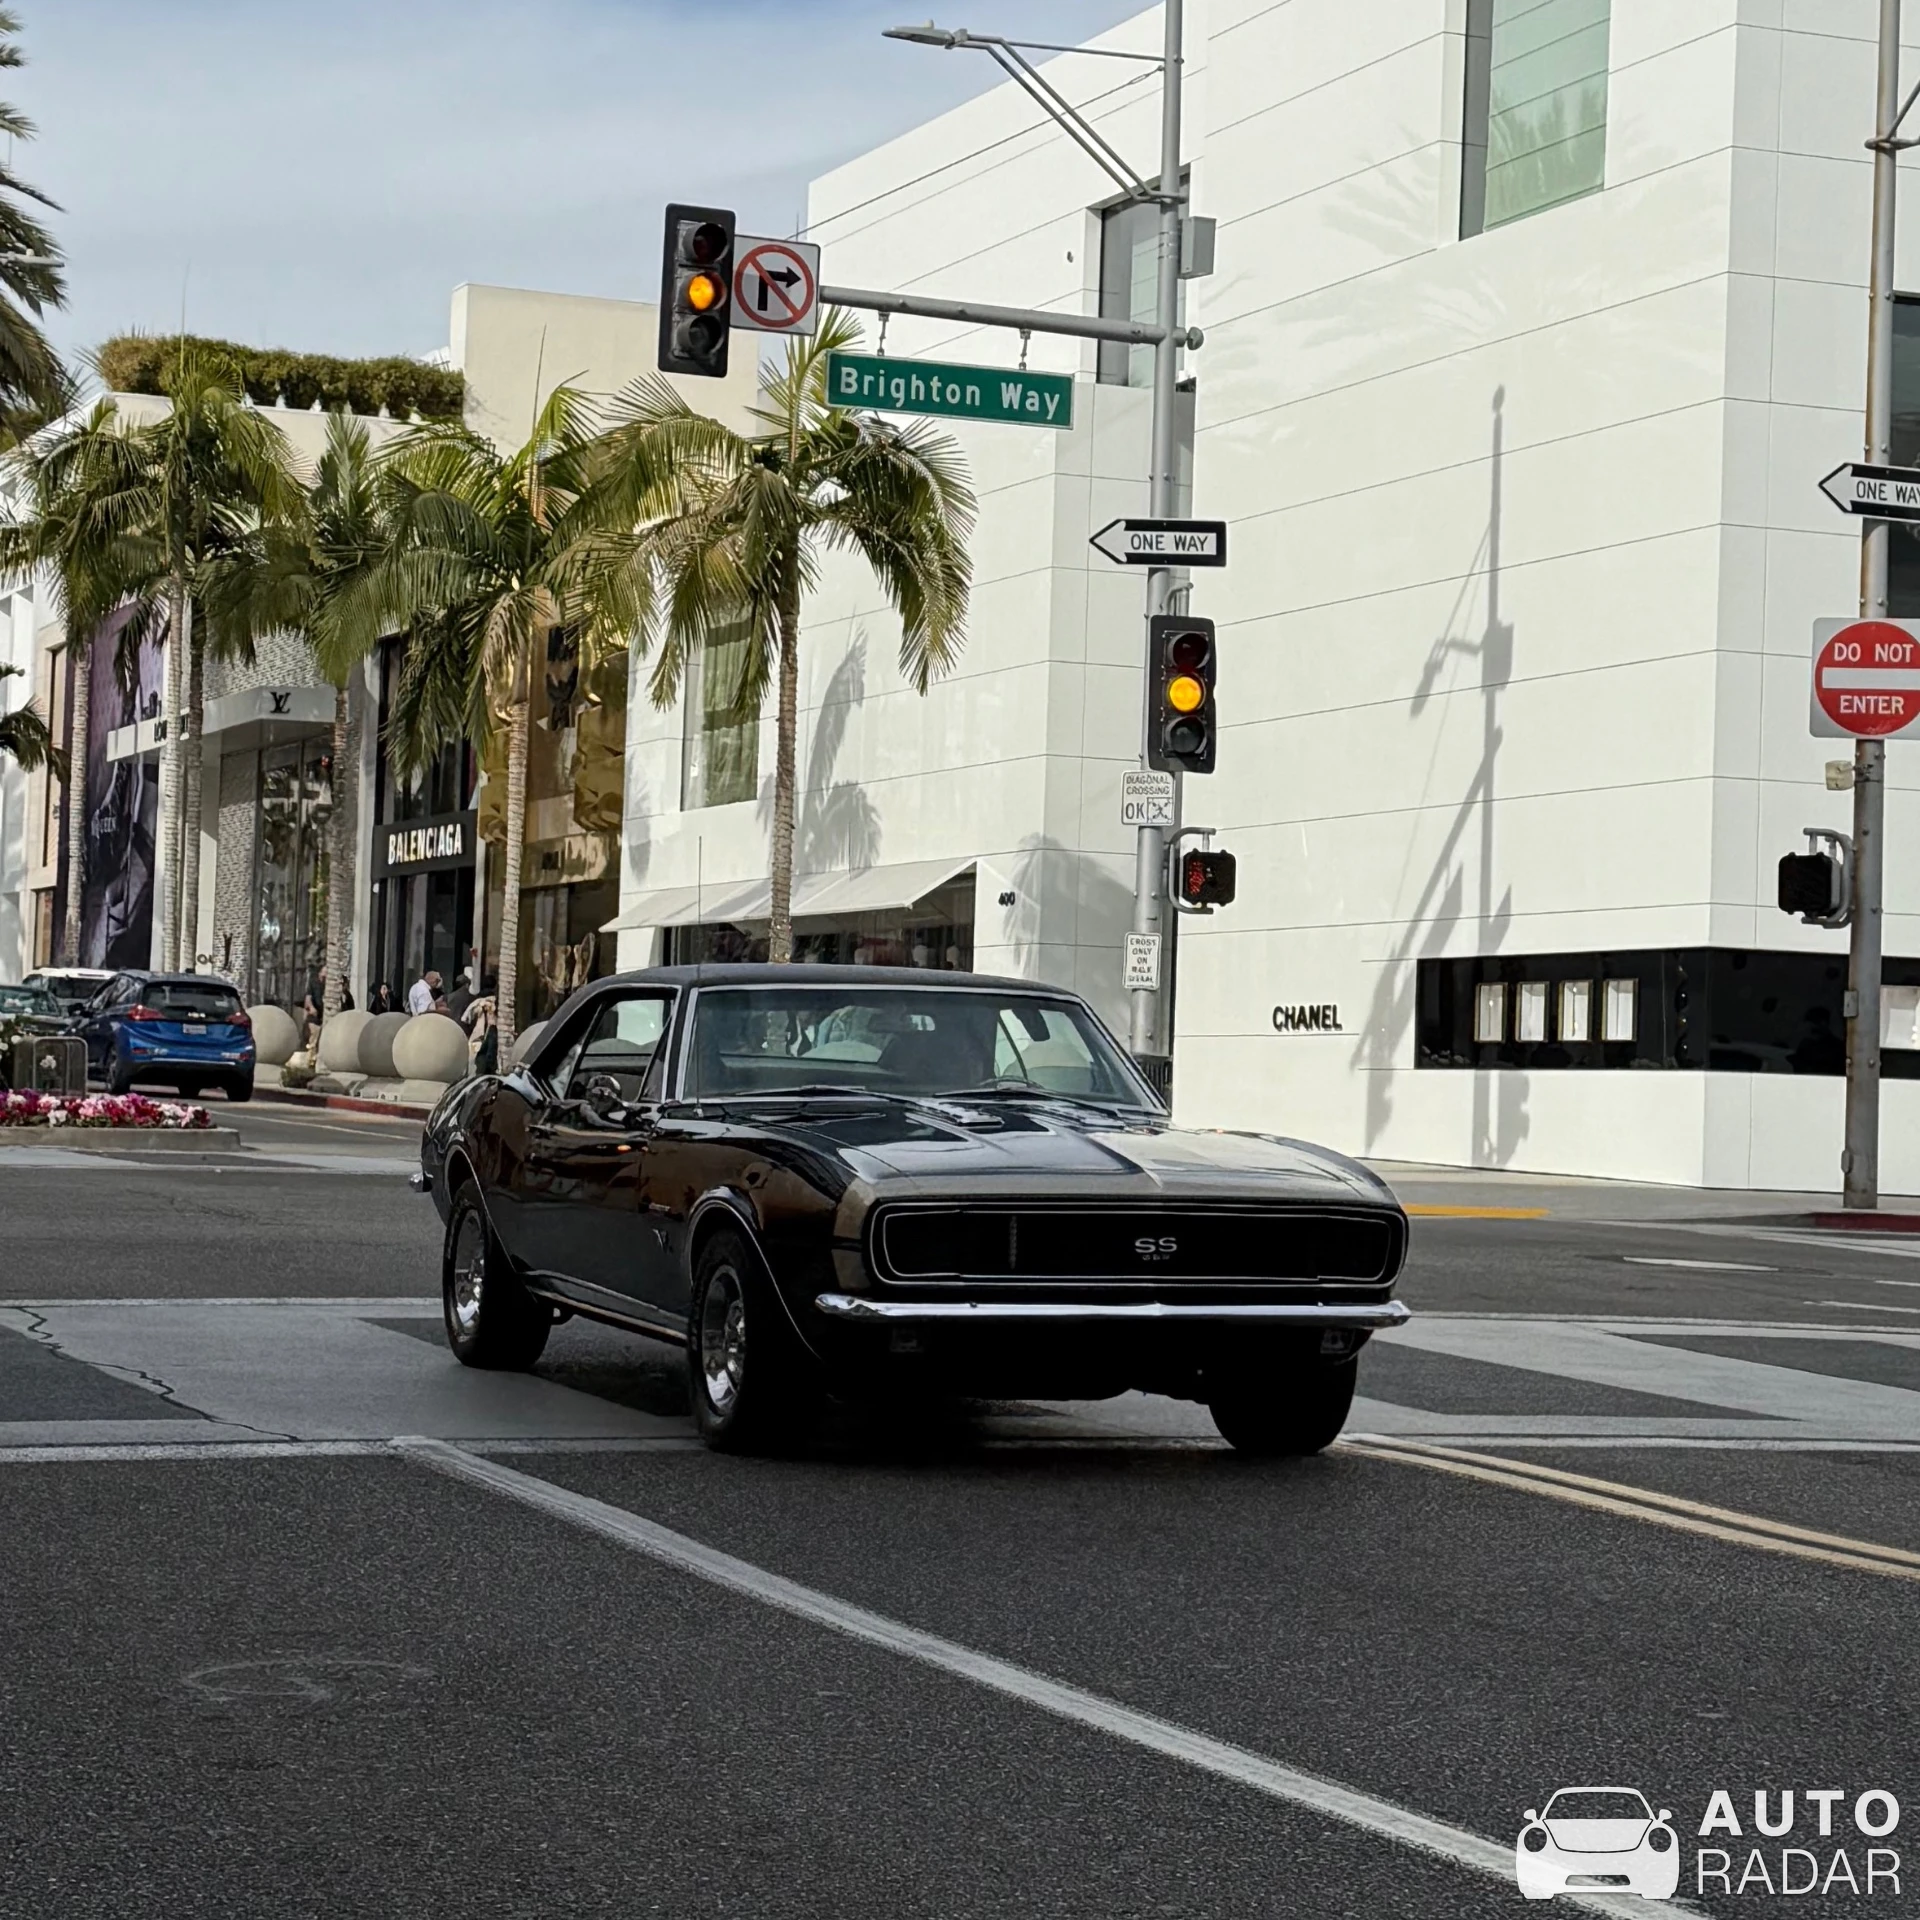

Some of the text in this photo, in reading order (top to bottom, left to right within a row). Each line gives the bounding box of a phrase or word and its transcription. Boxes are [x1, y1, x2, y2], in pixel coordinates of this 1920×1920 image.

[840, 366, 1060, 420] Brighton Way
[1856, 480, 1888, 501] ONE
[1130, 533, 1208, 552] ONE WAY
[1833, 642, 1914, 663] DO NOT
[1840, 695, 1904, 715] ENTER
[1126, 774, 1171, 785] DIAGONAL
[1126, 785, 1170, 795] CROSSING
[1125, 802, 1146, 820] OK
[388, 823, 463, 865] BALENCIAGA
[1130, 938, 1157, 946] CROSS
[1132, 947, 1152, 955] ONLY
[1137, 956, 1148, 964] ON
[1272, 1004, 1343, 1032] CHANEL
[1135, 1237, 1177, 1253] SS
